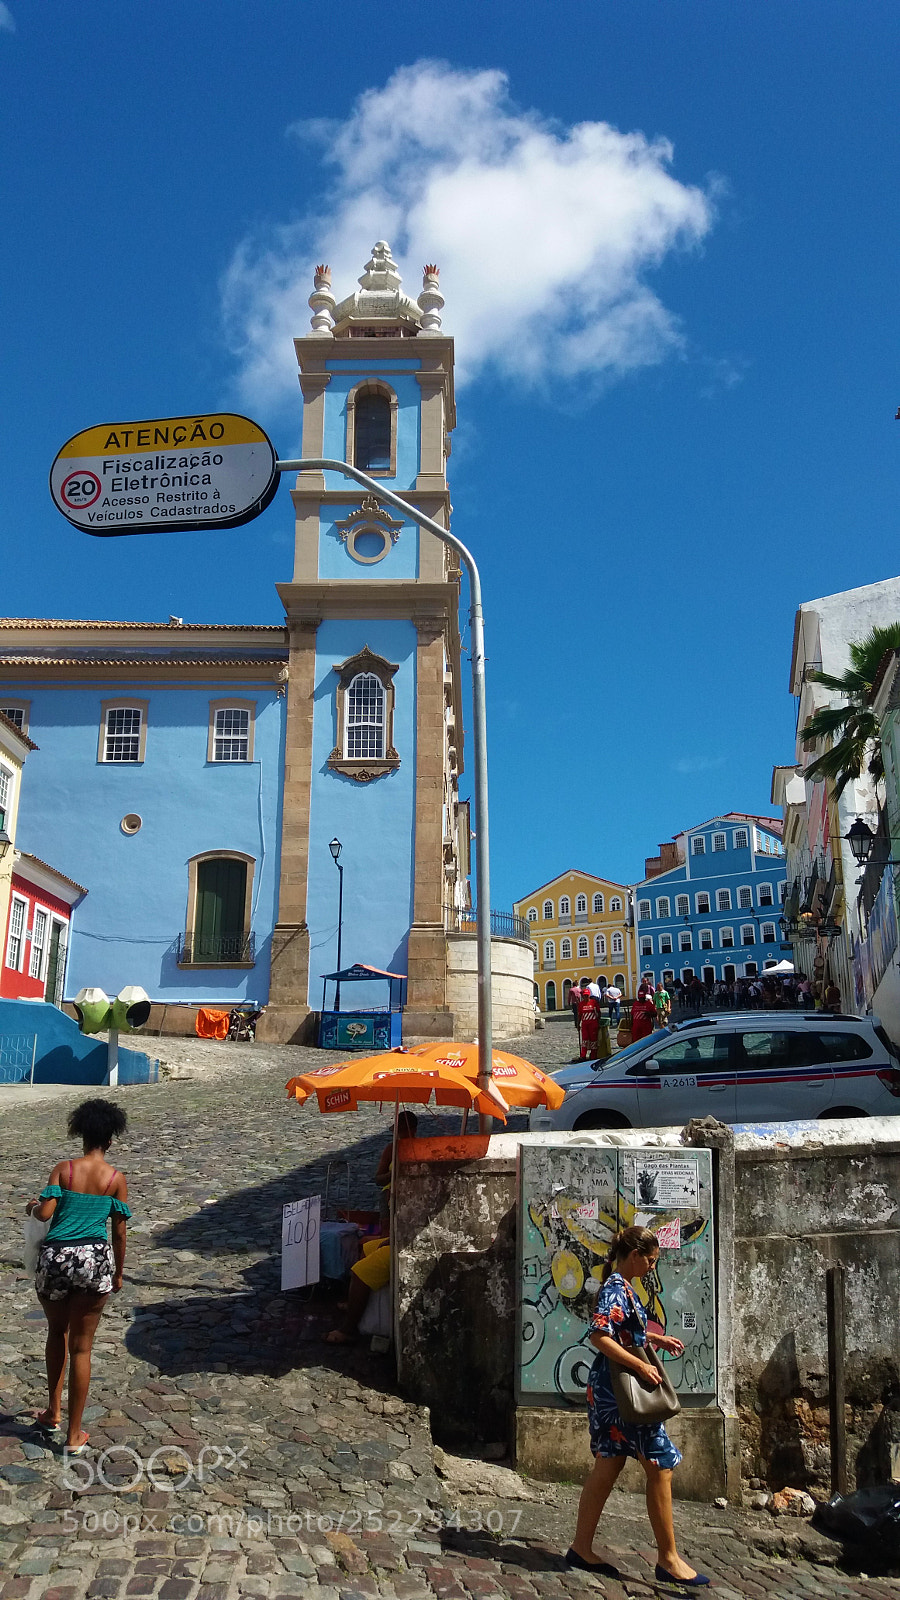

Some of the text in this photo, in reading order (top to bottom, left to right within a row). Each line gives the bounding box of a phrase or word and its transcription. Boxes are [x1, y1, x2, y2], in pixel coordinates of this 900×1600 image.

[103, 420, 225, 449] ATENÇÃO
[102, 451, 223, 475] Fiscalização
[67, 480, 96, 496] 20
[111, 472, 212, 492] Eletrônica
[102, 488, 221, 507] Acesso Restrito à
[88, 503, 236, 522] Veículos Cadastrados
[492, 1067, 517, 1076] SCHIN
[663, 1077, 696, 1088] A-2613
[326, 1092, 349, 1107] SCHIN
